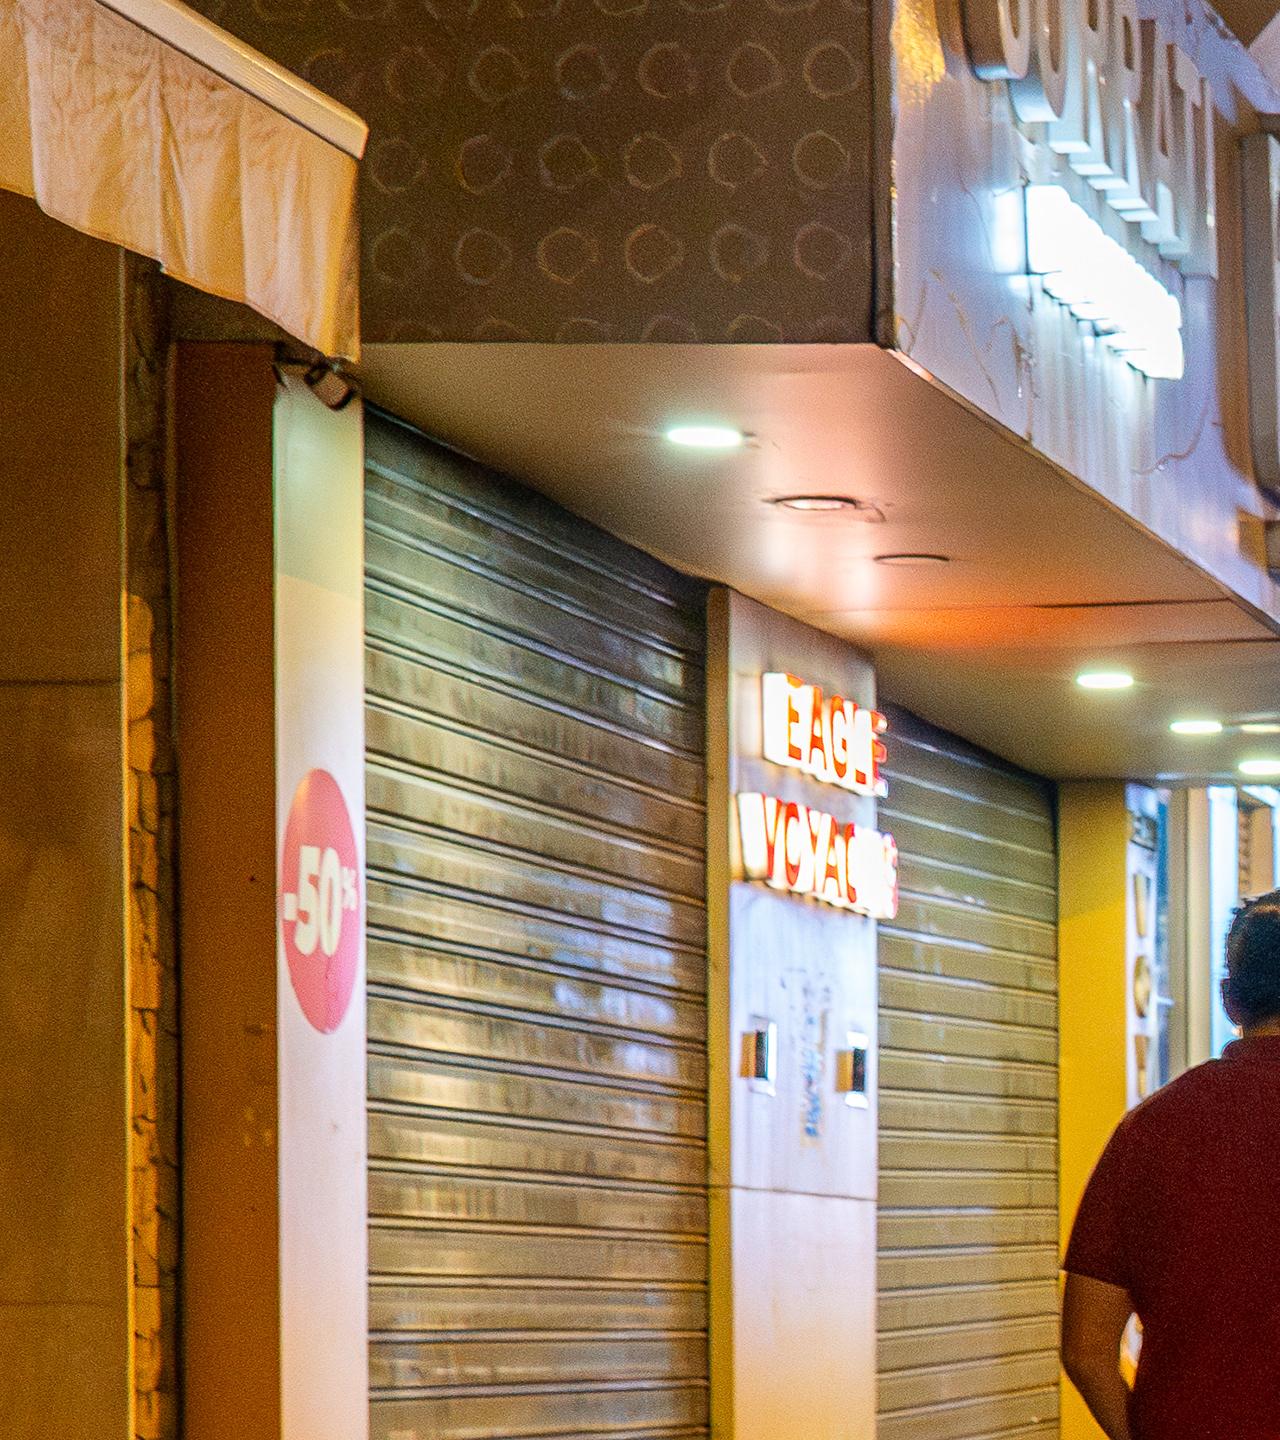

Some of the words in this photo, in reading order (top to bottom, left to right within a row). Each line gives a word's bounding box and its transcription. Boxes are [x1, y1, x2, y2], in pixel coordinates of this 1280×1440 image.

[762, 671, 889, 798] EAGLE
[283, 844, 357, 956] -50%
[738, 792, 898, 920] VOYAGS
